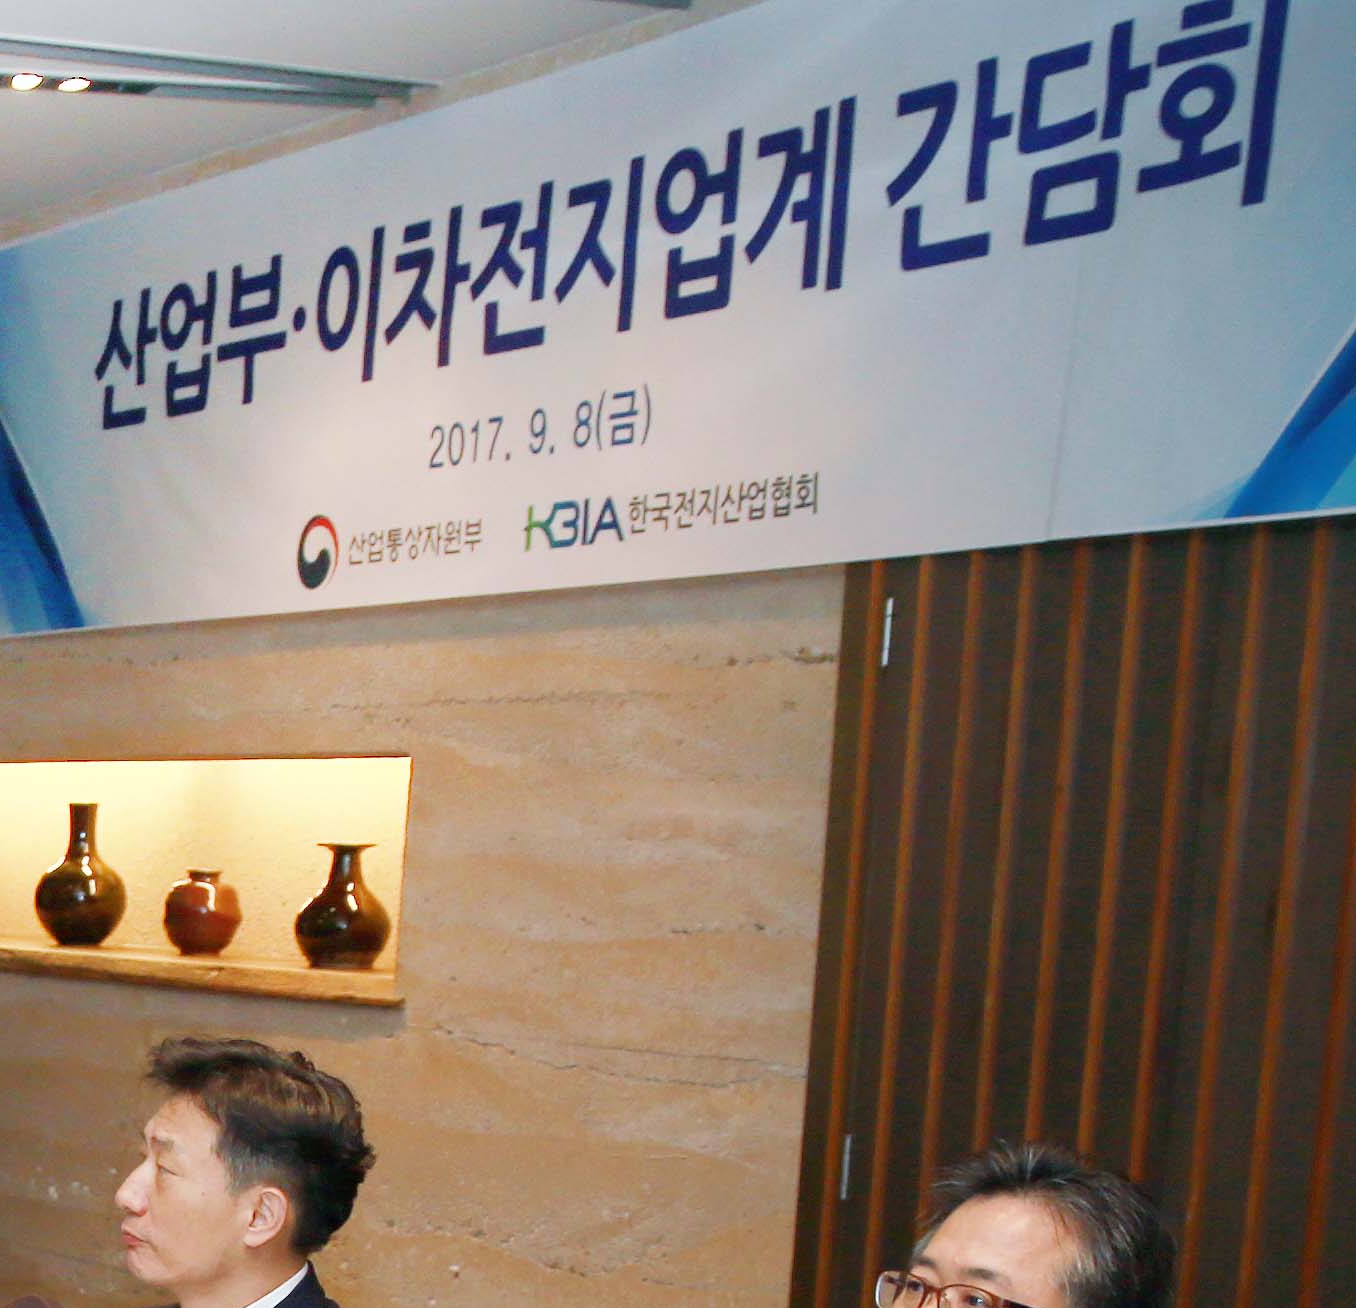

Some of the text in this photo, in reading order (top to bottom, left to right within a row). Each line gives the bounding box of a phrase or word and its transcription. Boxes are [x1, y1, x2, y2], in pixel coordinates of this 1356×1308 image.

[886, 0, 1289, 271] 간담회
[429, 416, 511, 469] 2017.
[573, 383, 652, 451] 8(금)
[628, 471, 819, 535] 한국전지산업협회
[348, 518, 482, 566] 산업통상자원부
